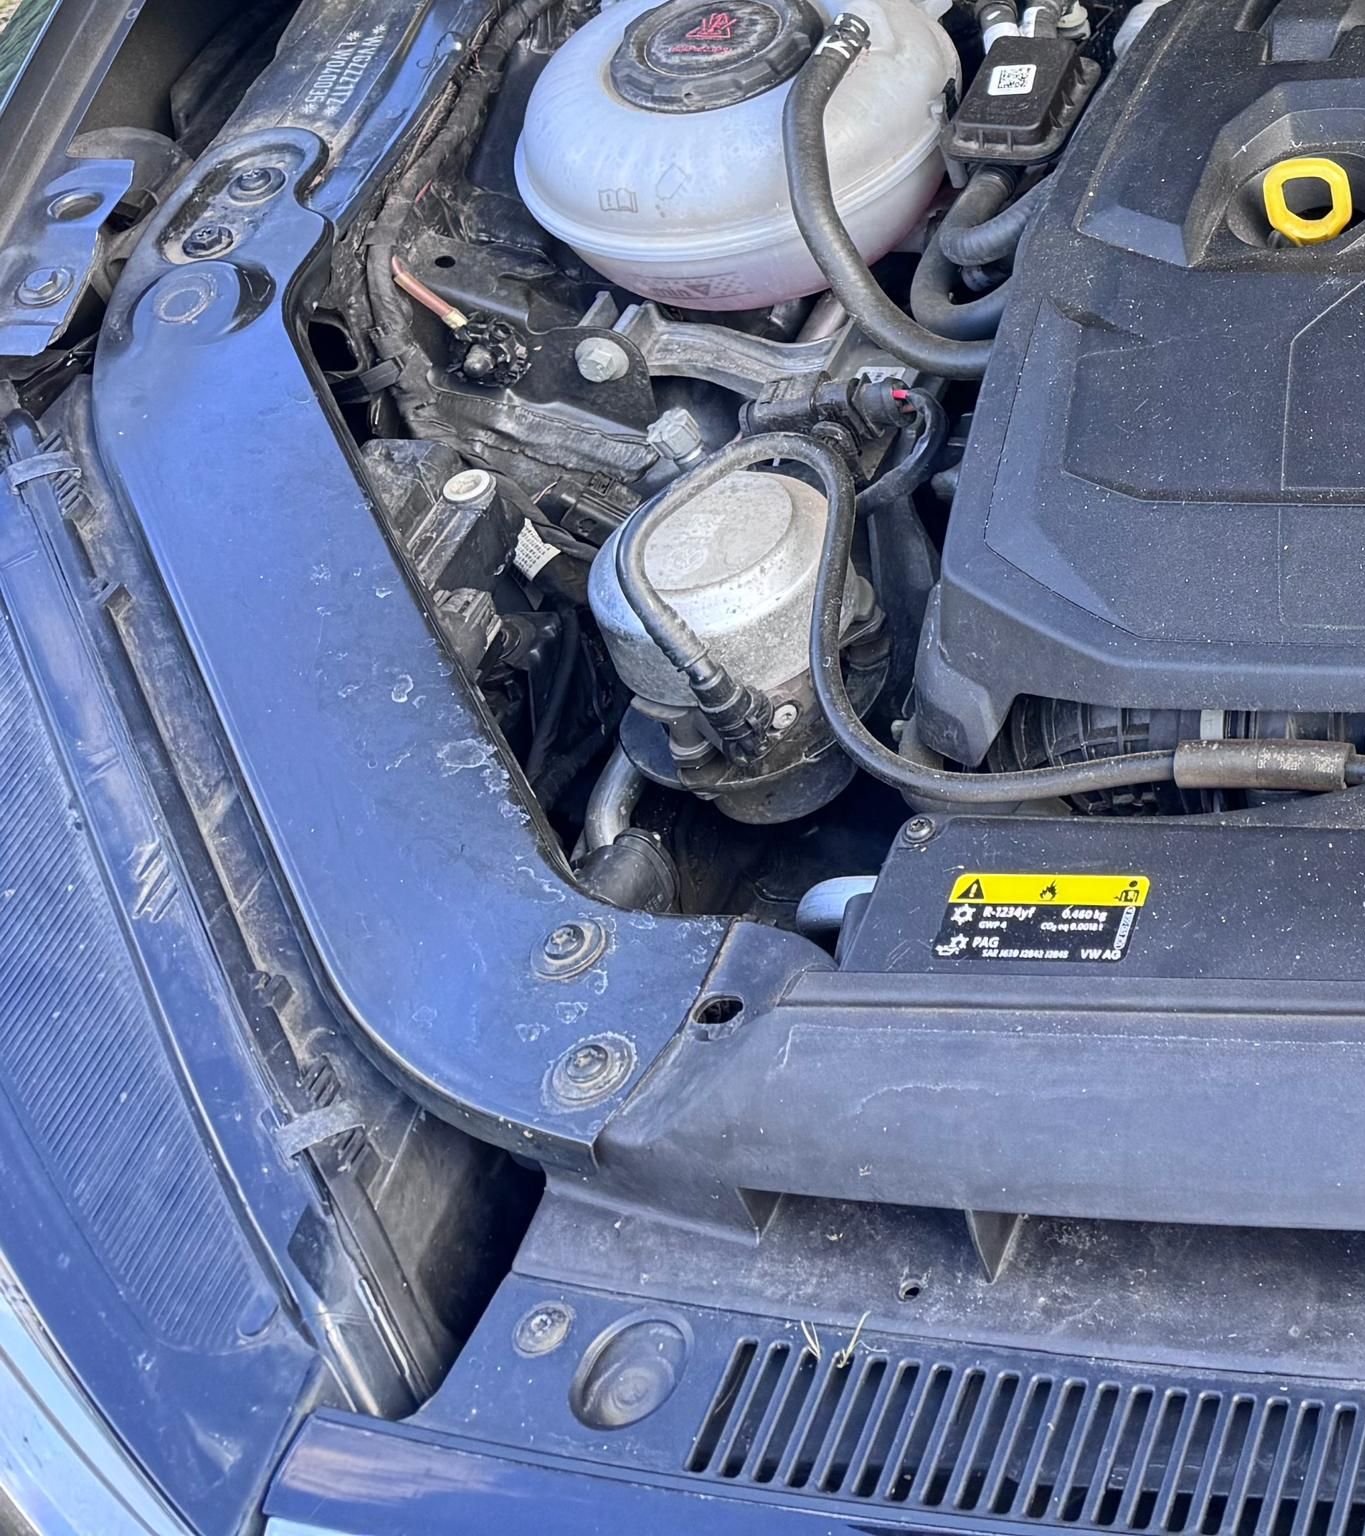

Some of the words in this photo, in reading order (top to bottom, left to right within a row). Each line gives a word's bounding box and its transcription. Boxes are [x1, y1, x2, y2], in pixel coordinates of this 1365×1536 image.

[983, 907, 1035, 921] R-1234yf
[1093, 909, 1108, 921] kg
[978, 921, 998, 930] GWP
[999, 921, 1008, 930] 4
[972, 936, 999, 949] PAG
[981, 949, 999, 958] SAE
[1080, 948, 1102, 960] VW
[1102, 948, 1122, 960] AG
